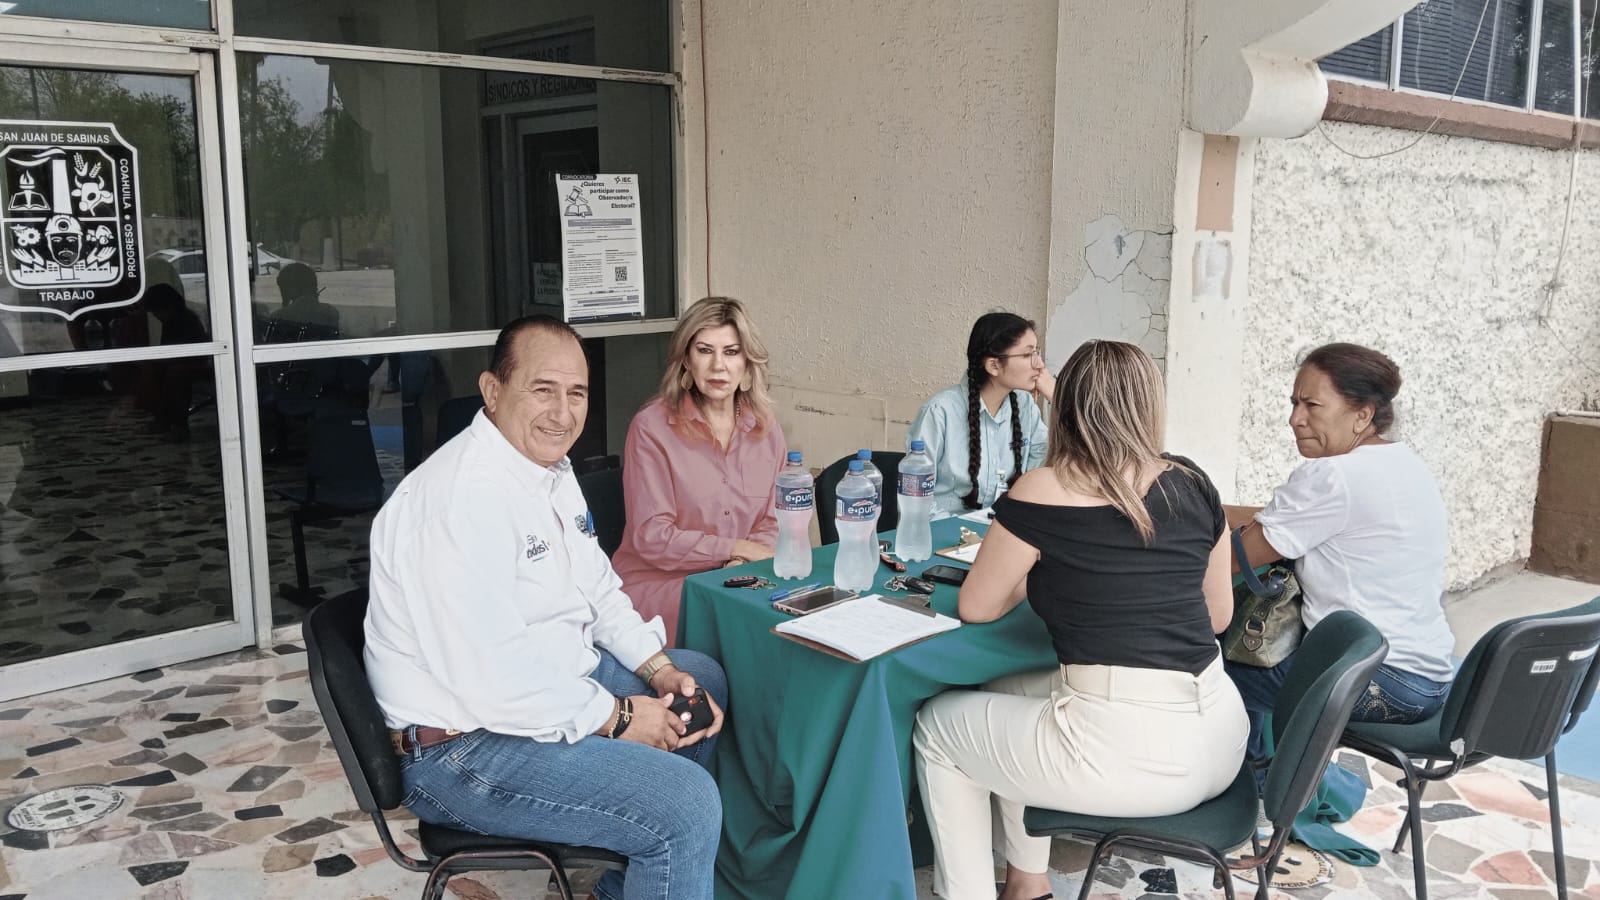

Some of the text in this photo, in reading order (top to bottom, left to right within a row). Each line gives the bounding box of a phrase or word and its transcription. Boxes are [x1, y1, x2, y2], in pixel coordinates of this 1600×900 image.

[531, 78, 538, 96] Y
[0, 131, 110, 144] SAN JUAN DE SABINAS
[119, 158, 132, 210] COAHUILA
[124, 224, 137, 279] PROGRESO
[39, 289, 95, 302] TRABAJO
